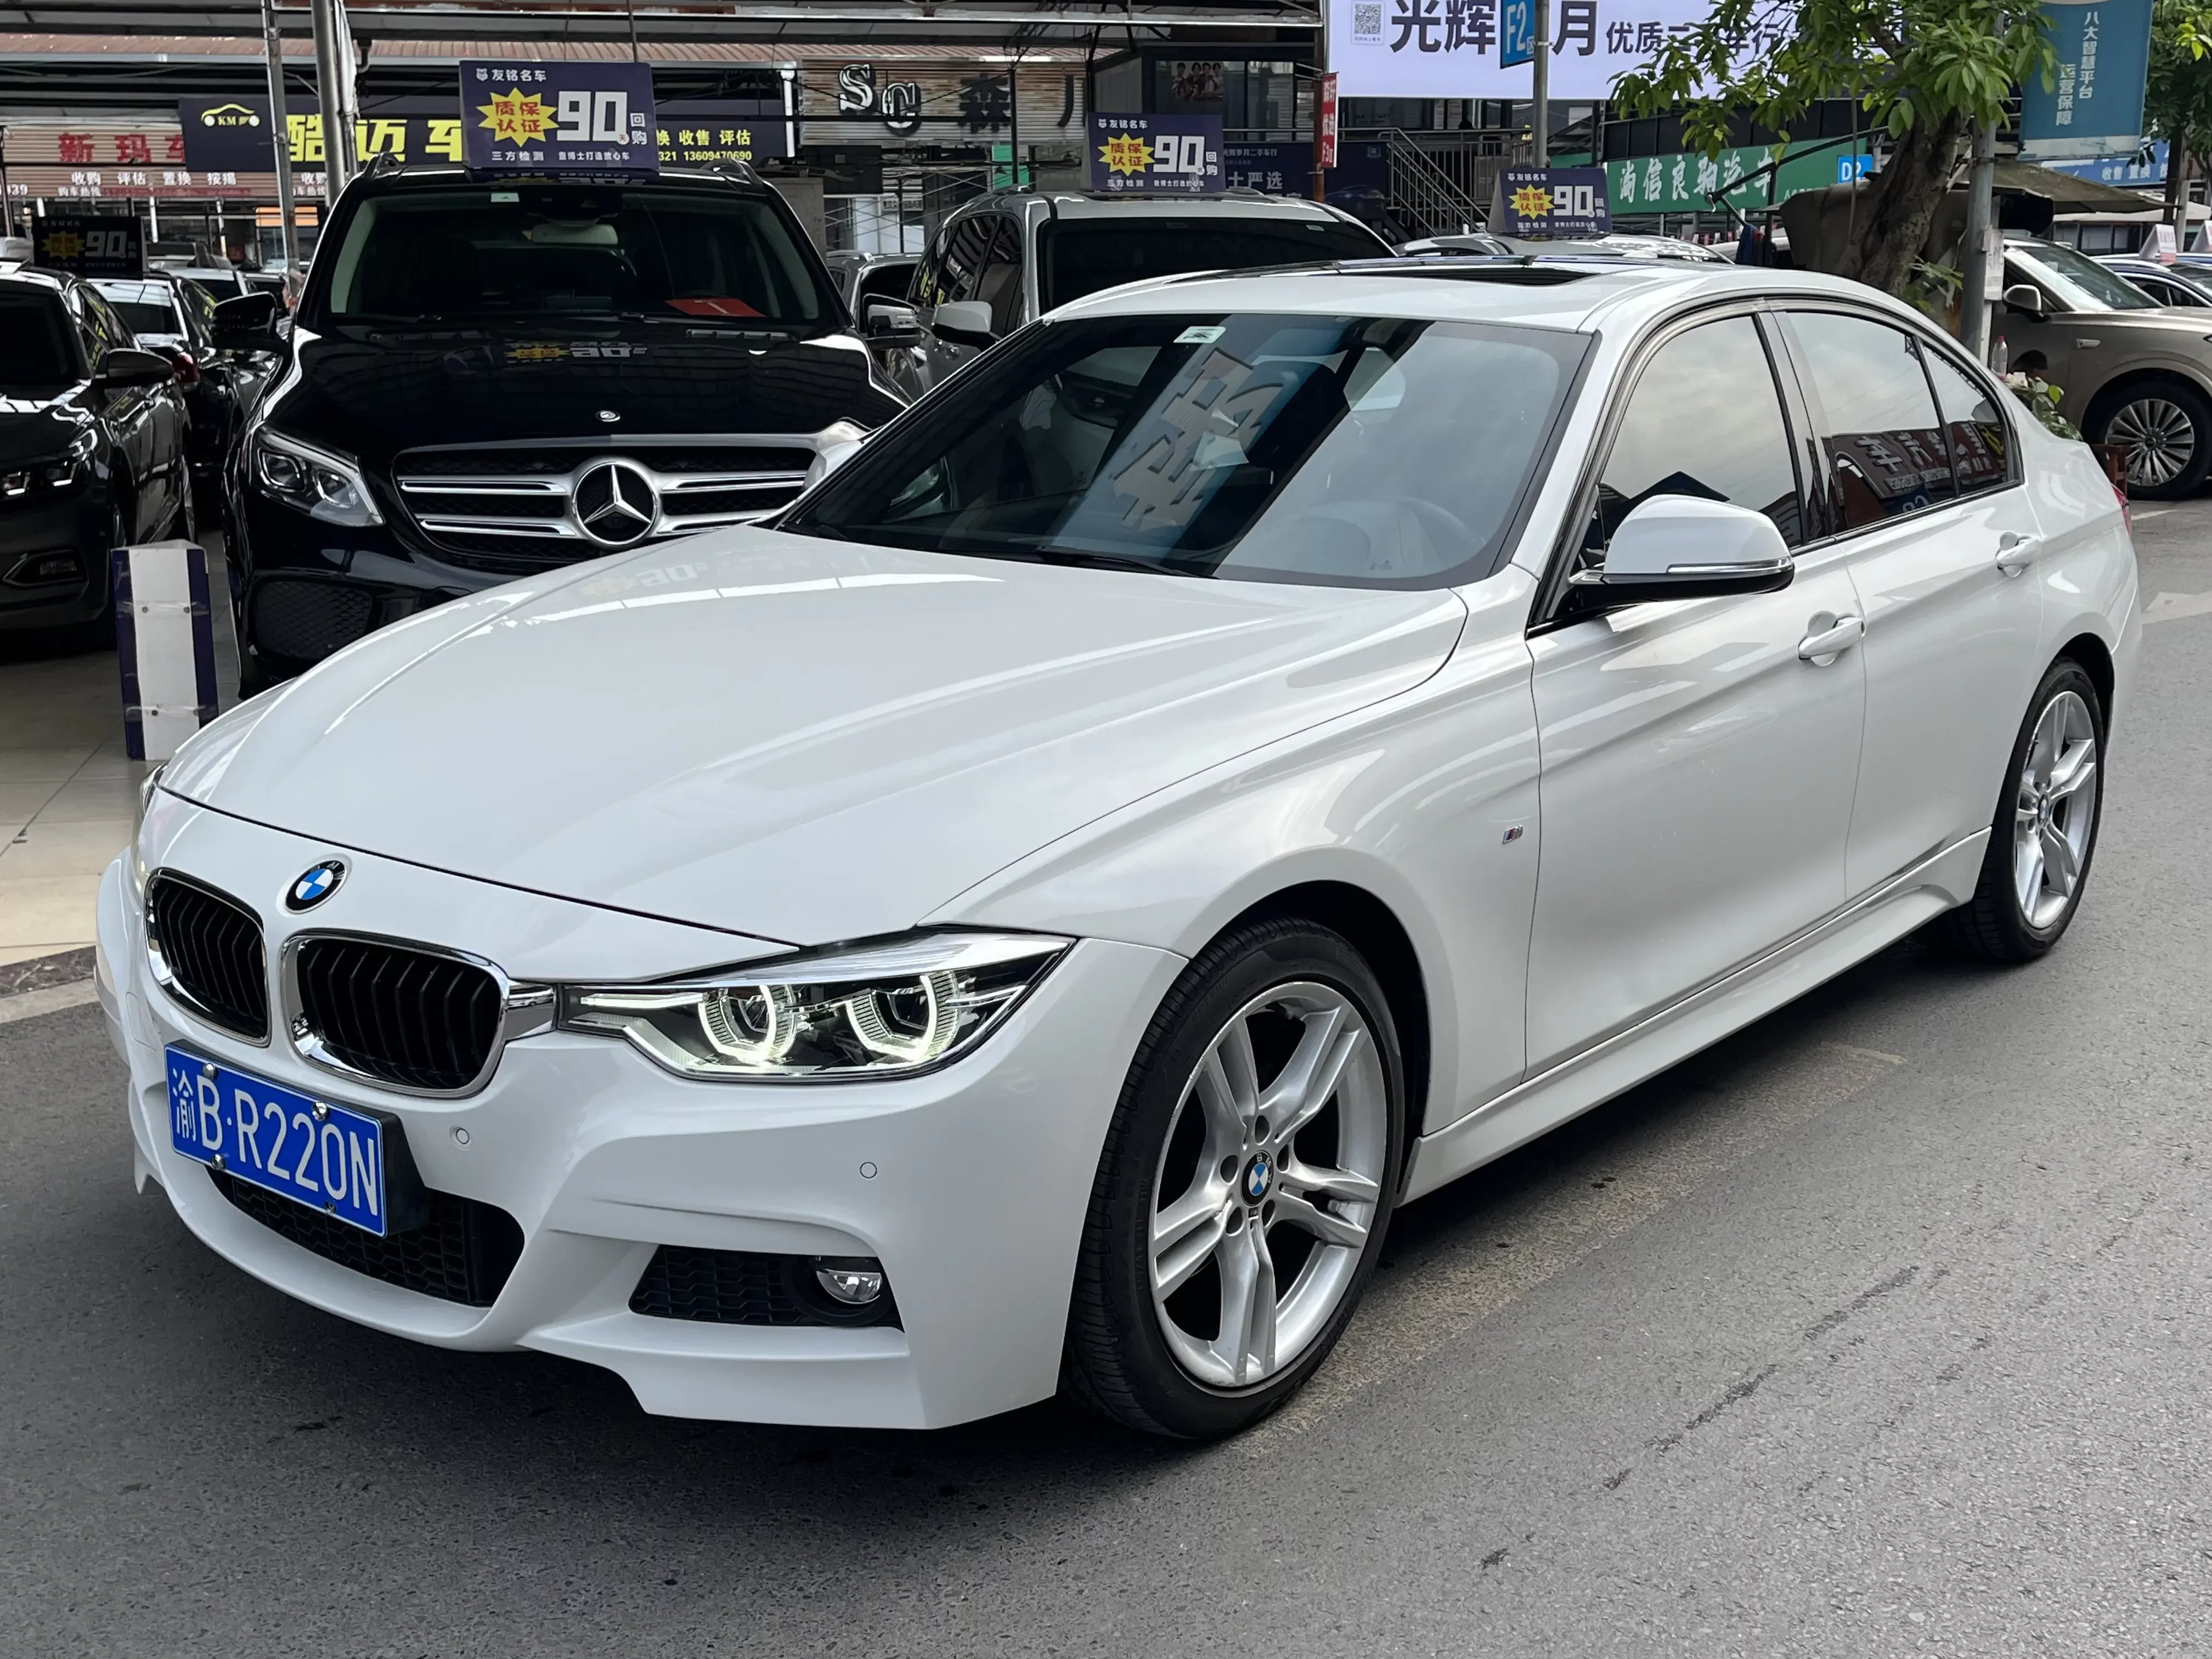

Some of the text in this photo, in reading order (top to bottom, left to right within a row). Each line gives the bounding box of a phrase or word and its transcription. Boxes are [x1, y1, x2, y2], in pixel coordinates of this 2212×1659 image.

[1390, 0, 1597, 55] 光辉月
[2079, 11, 2100, 99] 八大智慧平台
[492, 69, 546, 82] 友铭名车
[494, 101, 540, 116] 质保
[2056, 64, 2076, 126] 运营保障
[218, 117, 236, 126] KM
[496, 119, 543, 133] 认证
[556, 91, 628, 142] 90
[630, 112, 647, 145] 回购
[679, 129, 710, 146] 收售
[719, 129, 751, 146] 评估
[1110, 143, 1142, 154] 质保
[492, 151, 544, 161] 三方检测
[1111, 156, 1143, 166] 认证
[1153, 135, 1205, 173] 90
[1554, 185, 1593, 216] 90
[85, 231, 127, 258] 90
[172, 1067, 379, 1216] 渝B·R220N
